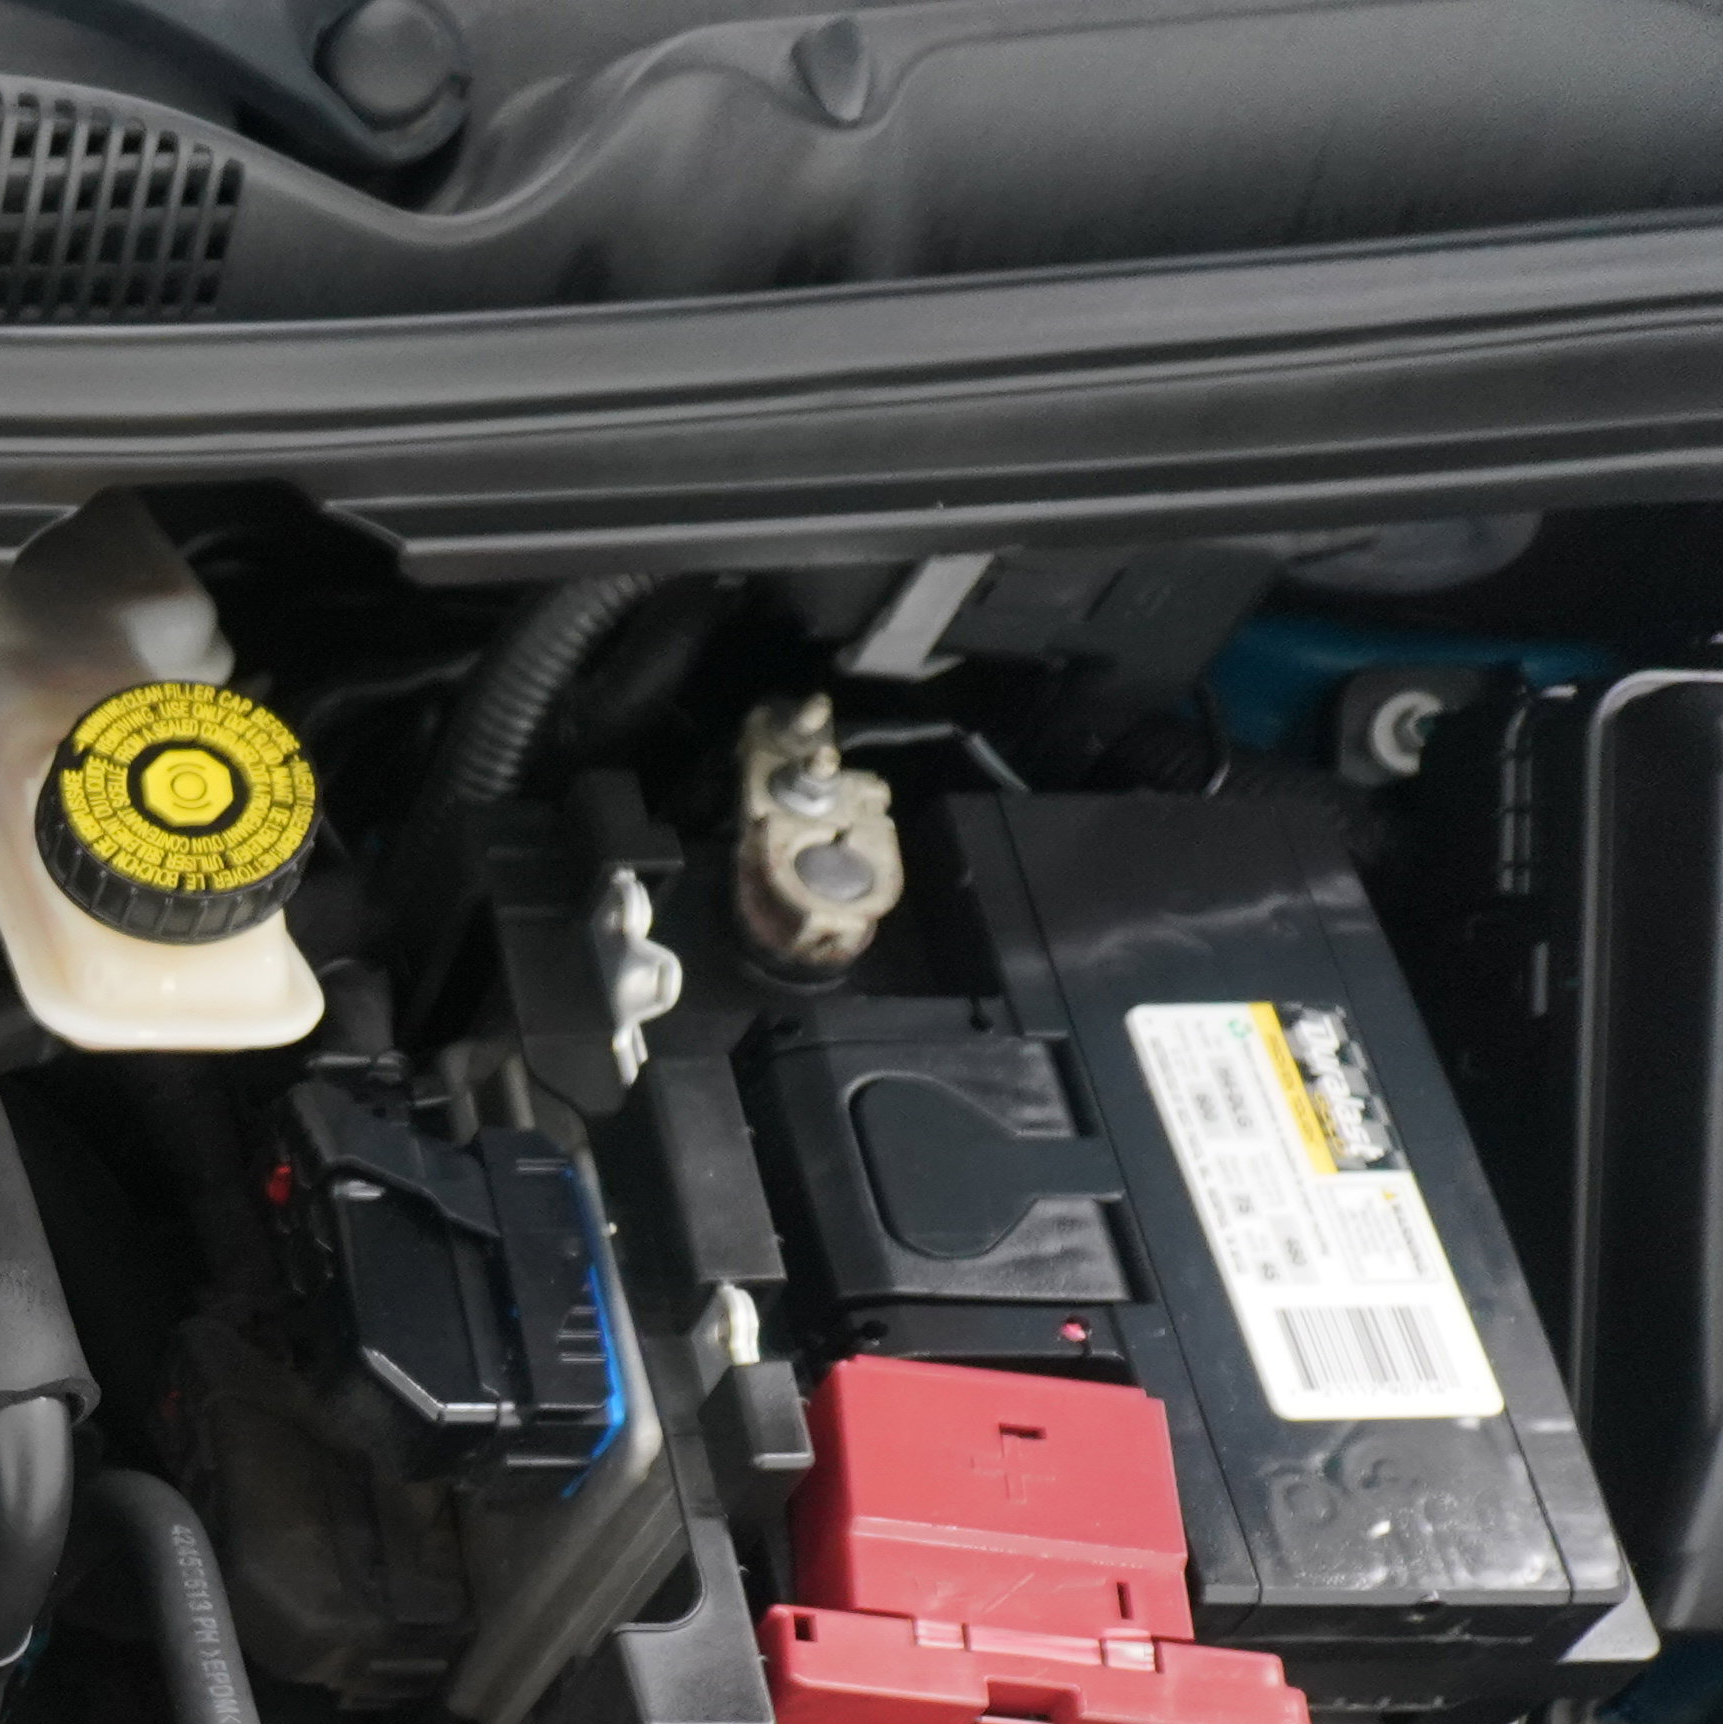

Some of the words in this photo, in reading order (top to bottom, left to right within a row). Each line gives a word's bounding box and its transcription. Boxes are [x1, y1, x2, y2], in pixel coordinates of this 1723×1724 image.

[164, 682, 216, 703] FILLER
[217, 689, 254, 715] CAP
[158, 700, 190, 719] USE
[192, 701, 225, 723] ONLY
[151, 718, 200, 739] SEALED
[90, 836, 120, 860] DE
[110, 851, 180, 889] BOUCHON
[163, 852, 226, 874] UTILISER
[185, 872, 207, 891] LE
